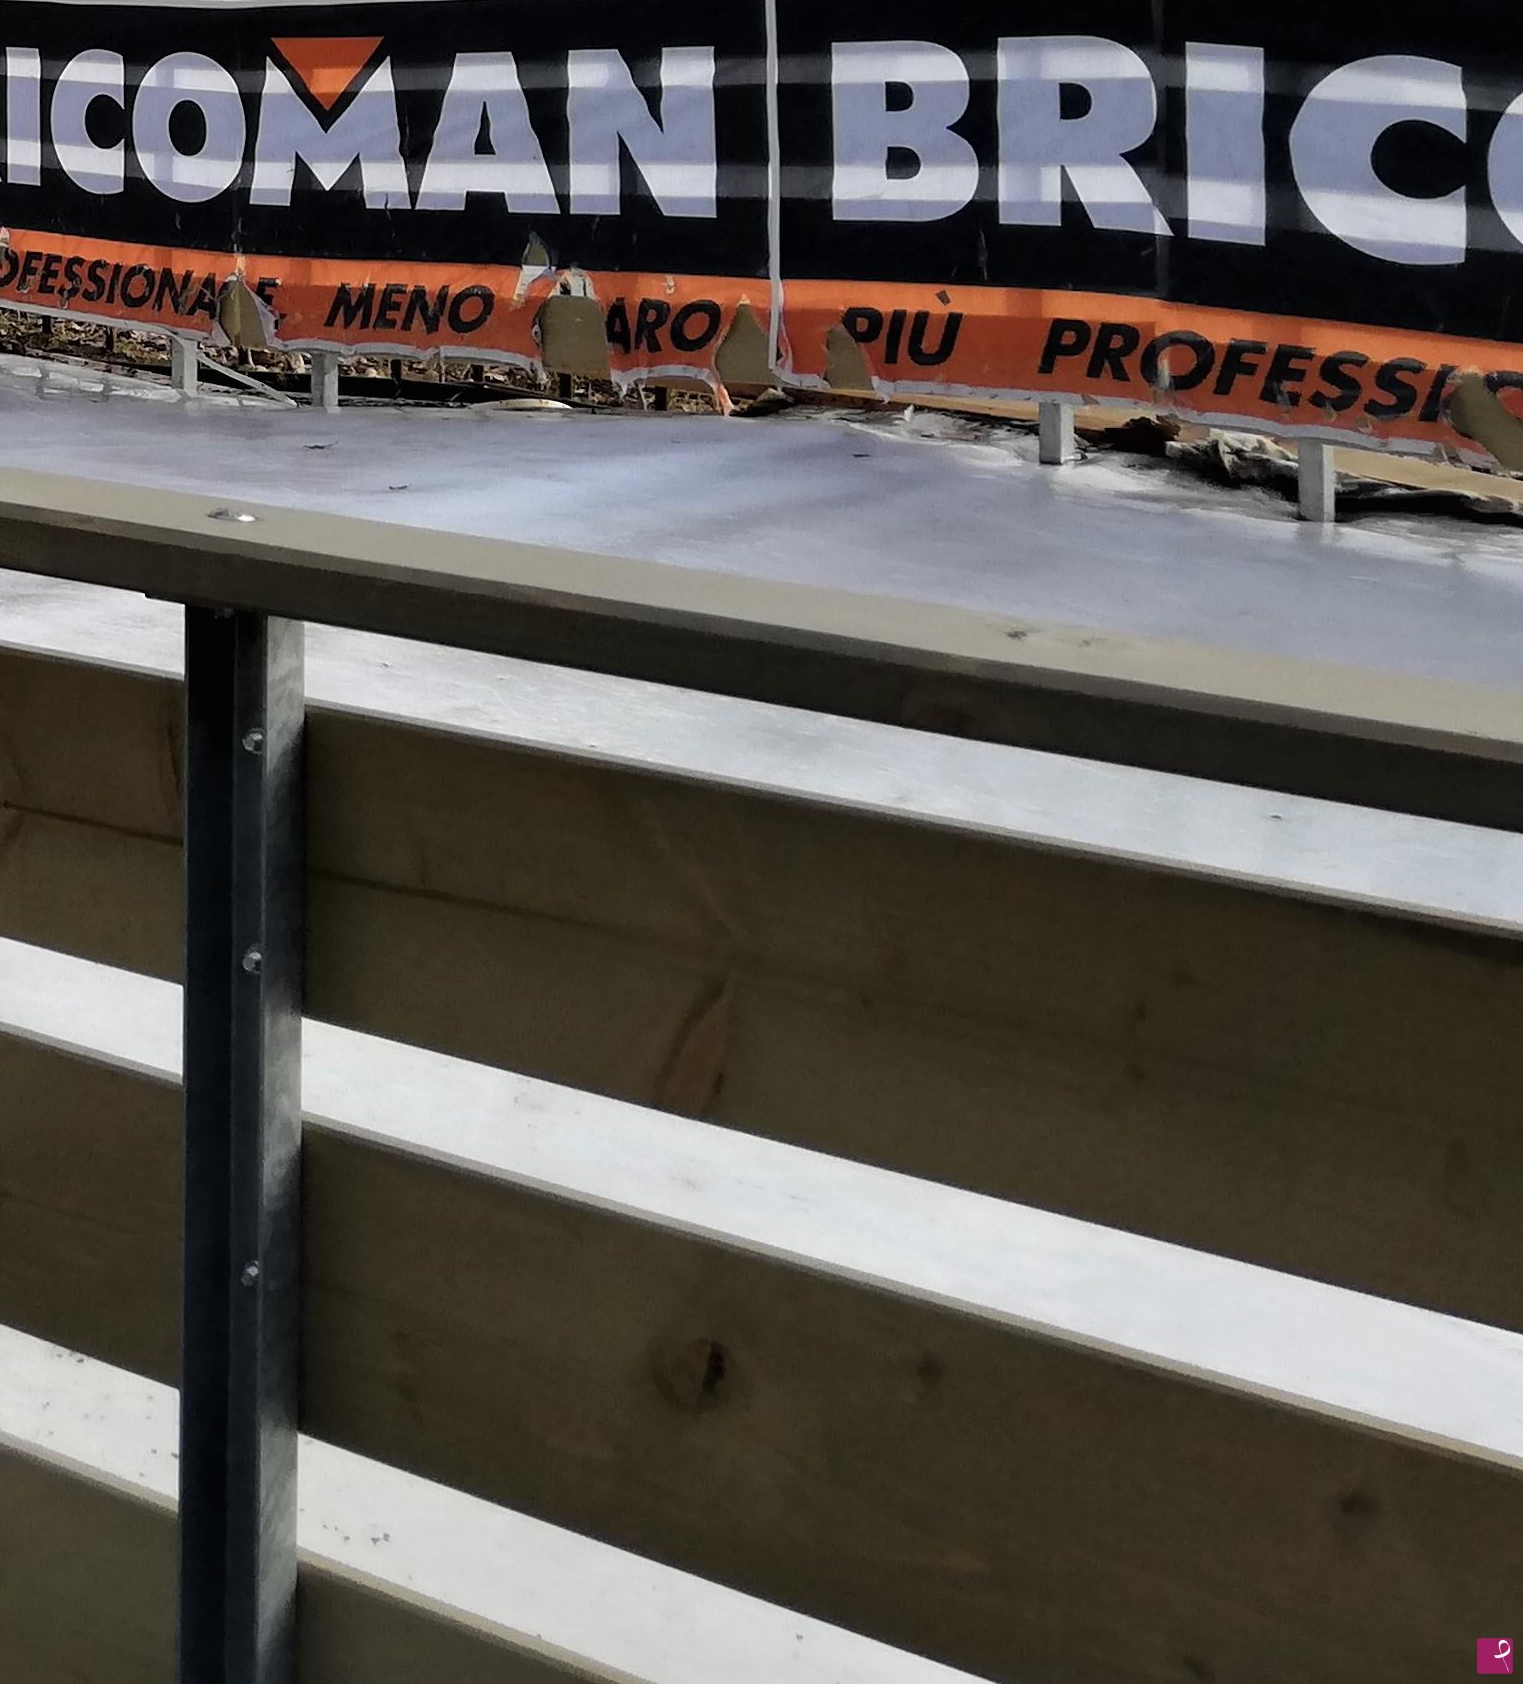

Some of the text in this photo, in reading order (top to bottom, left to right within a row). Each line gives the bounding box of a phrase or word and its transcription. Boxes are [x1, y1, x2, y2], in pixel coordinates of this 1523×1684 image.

[831, 36, 1523, 266] BRIC
[323, 283, 495, 334] MENO
[532, 280, 722, 355] ARO
[842, 290, 963, 366] PIÙ
